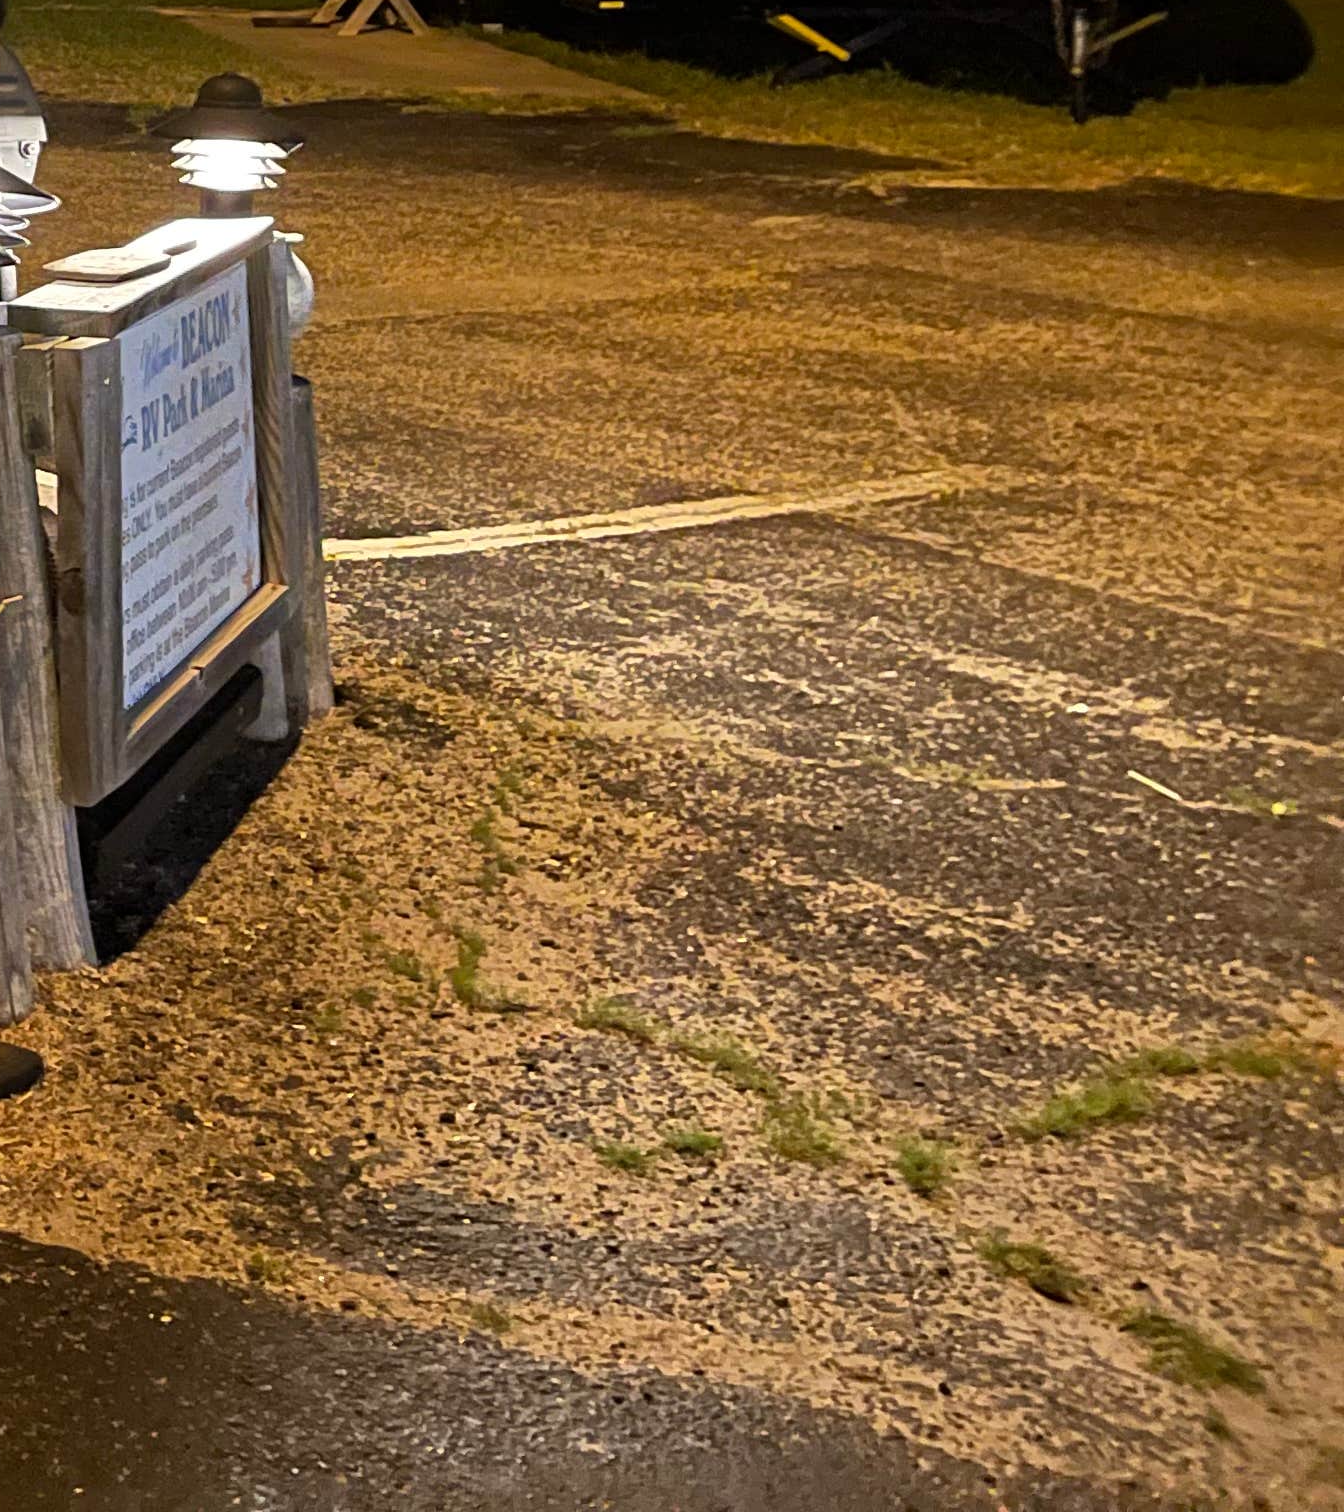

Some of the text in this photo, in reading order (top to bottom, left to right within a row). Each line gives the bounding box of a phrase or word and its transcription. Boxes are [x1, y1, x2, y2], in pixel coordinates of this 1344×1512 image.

[181, 293, 229, 368] BEACON
[141, 399, 159, 451] RV
[163, 385, 187, 436] Park
[201, 362, 234, 411] Marina
